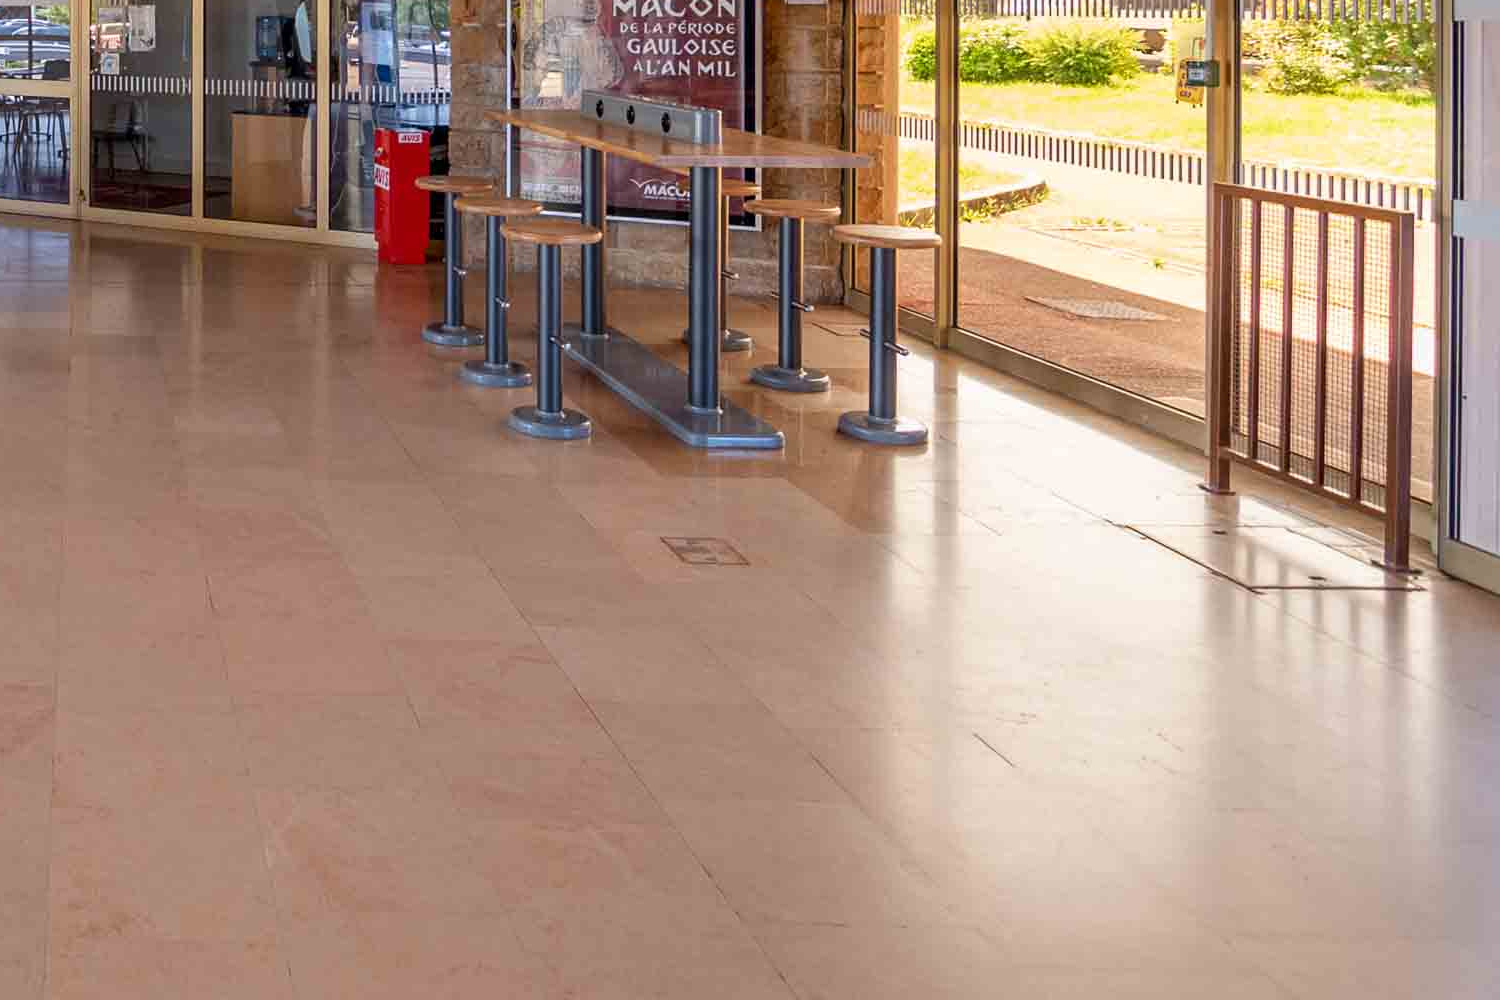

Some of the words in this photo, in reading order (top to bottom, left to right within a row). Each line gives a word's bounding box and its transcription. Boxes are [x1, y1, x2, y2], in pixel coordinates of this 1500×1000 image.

[620, 22, 638, 34] DE
[644, 22, 663, 34] LA
[668, 20, 736, 37] PÉRIODE
[626, 38, 736, 56] GAULOISE
[646, 59, 691, 77] L'AN
[697, 60, 736, 77] MIL
[400, 133, 422, 143] AVIS
[374, 167, 389, 187] AVIS
